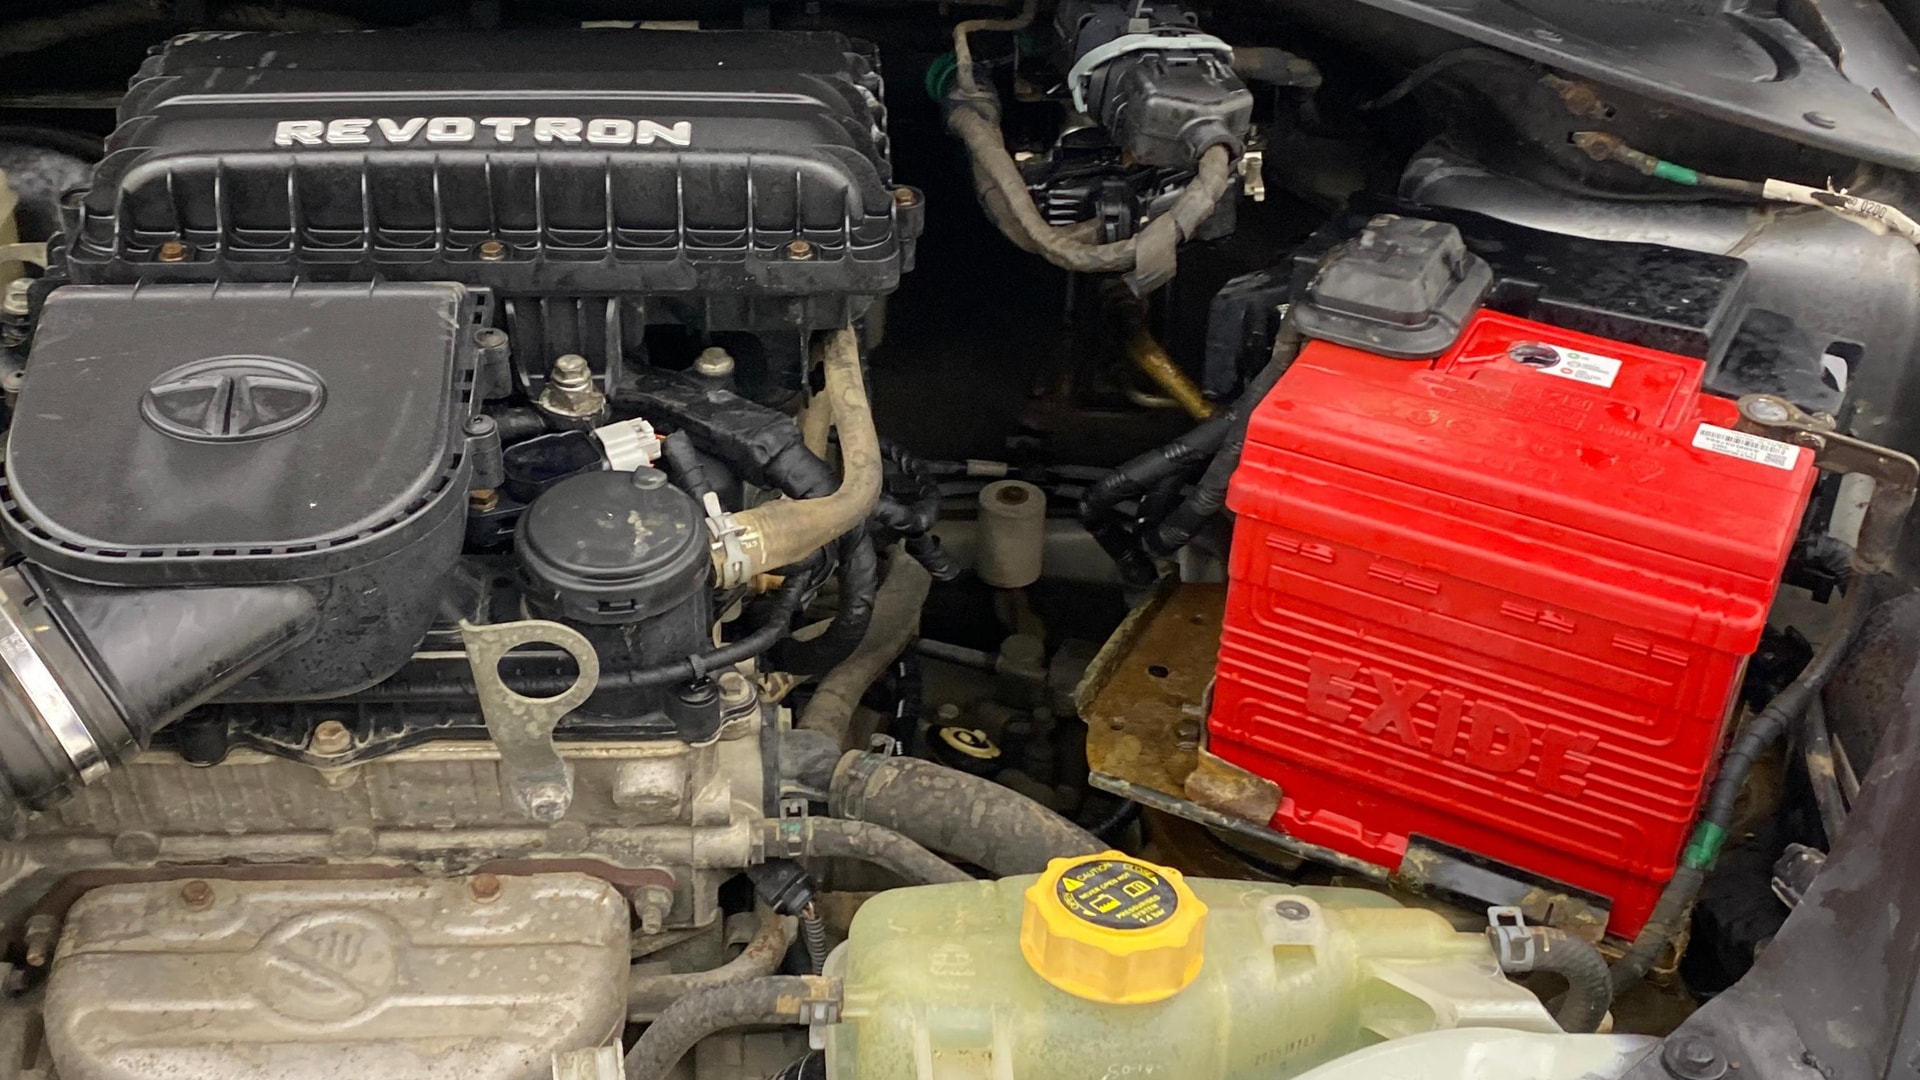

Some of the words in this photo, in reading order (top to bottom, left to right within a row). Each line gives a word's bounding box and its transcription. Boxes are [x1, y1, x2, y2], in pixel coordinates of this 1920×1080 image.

[274, 116, 692, 147] REVOTRON
[1861, 200, 1887, 219] 0200
[1304, 651, 1600, 799] EXIDE
[1076, 862, 1113, 881] CAUTION
[1079, 886, 1101, 900] NEVER
[1100, 878, 1119, 890] OPEN
[1116, 872, 1131, 882] NOT
